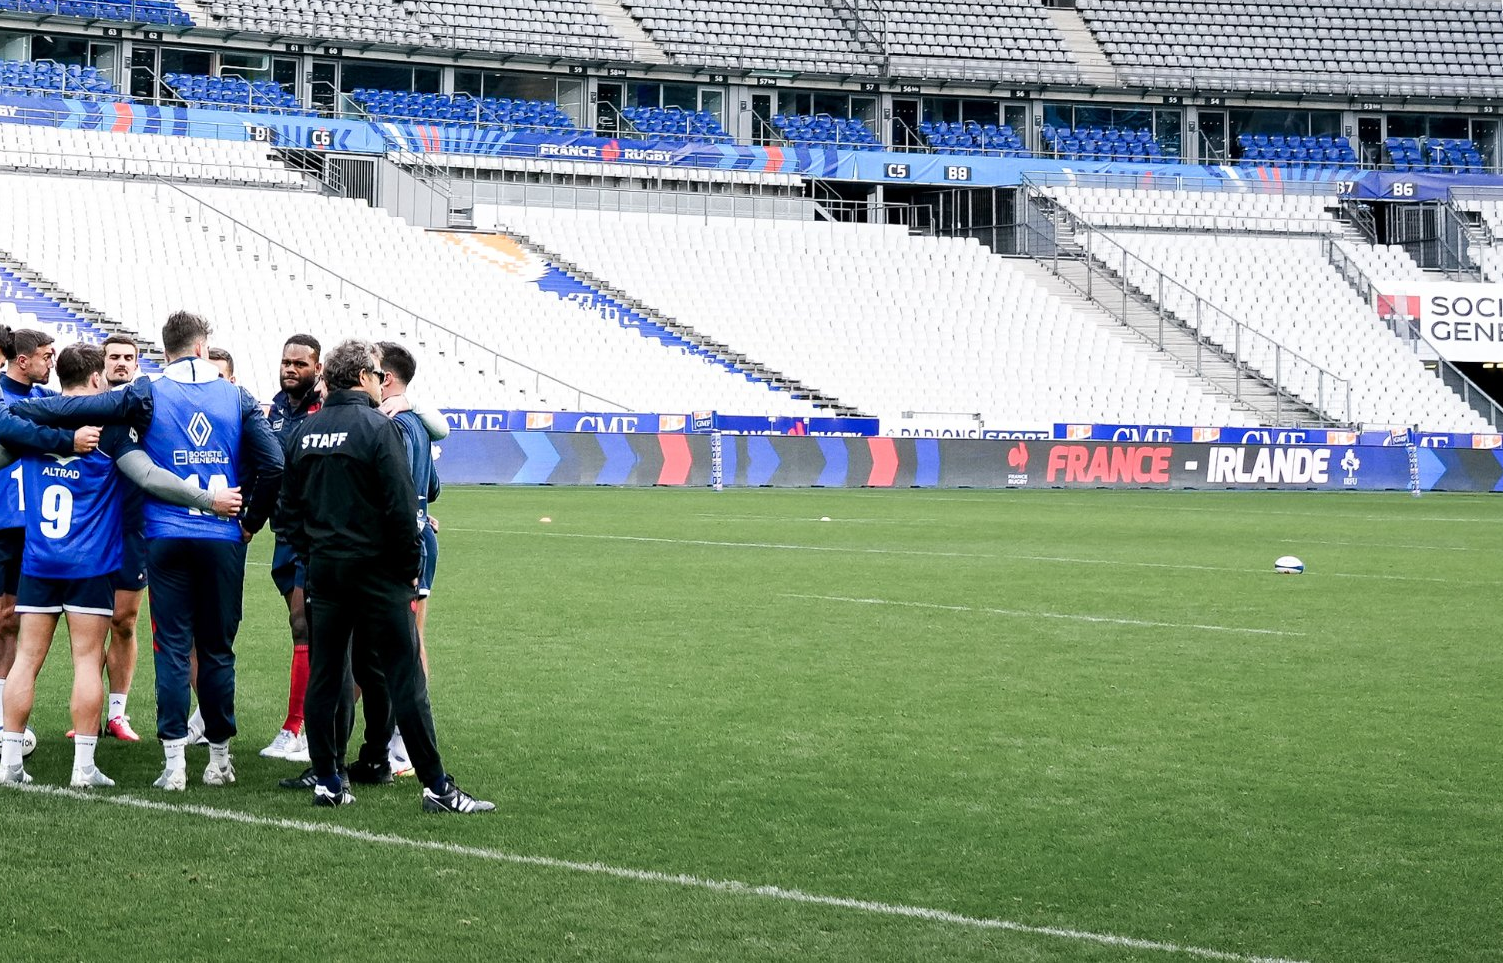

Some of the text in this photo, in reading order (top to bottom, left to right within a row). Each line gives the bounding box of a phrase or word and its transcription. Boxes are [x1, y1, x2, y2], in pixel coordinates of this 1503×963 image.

[108, 28, 117, 36] 63
[149, 32, 158, 40] 62
[290, 44, 299, 52] 61
[312, 130, 330, 146] C6
[538, 144, 673, 161] FRANCE RUGBY
[888, 164, 907, 178] C5
[948, 166, 967, 180] B8
[1393, 182, 1413, 196] B6
[1431, 296, 1503, 317] SOCI
[301, 432, 348, 449] STAFF
[1047, 445, 1172, 484] FRANCE
[1206, 446, 1331, 484] IRLANDE
[42, 466, 80, 480] ALTRAD
[39, 484, 73, 539] 9
